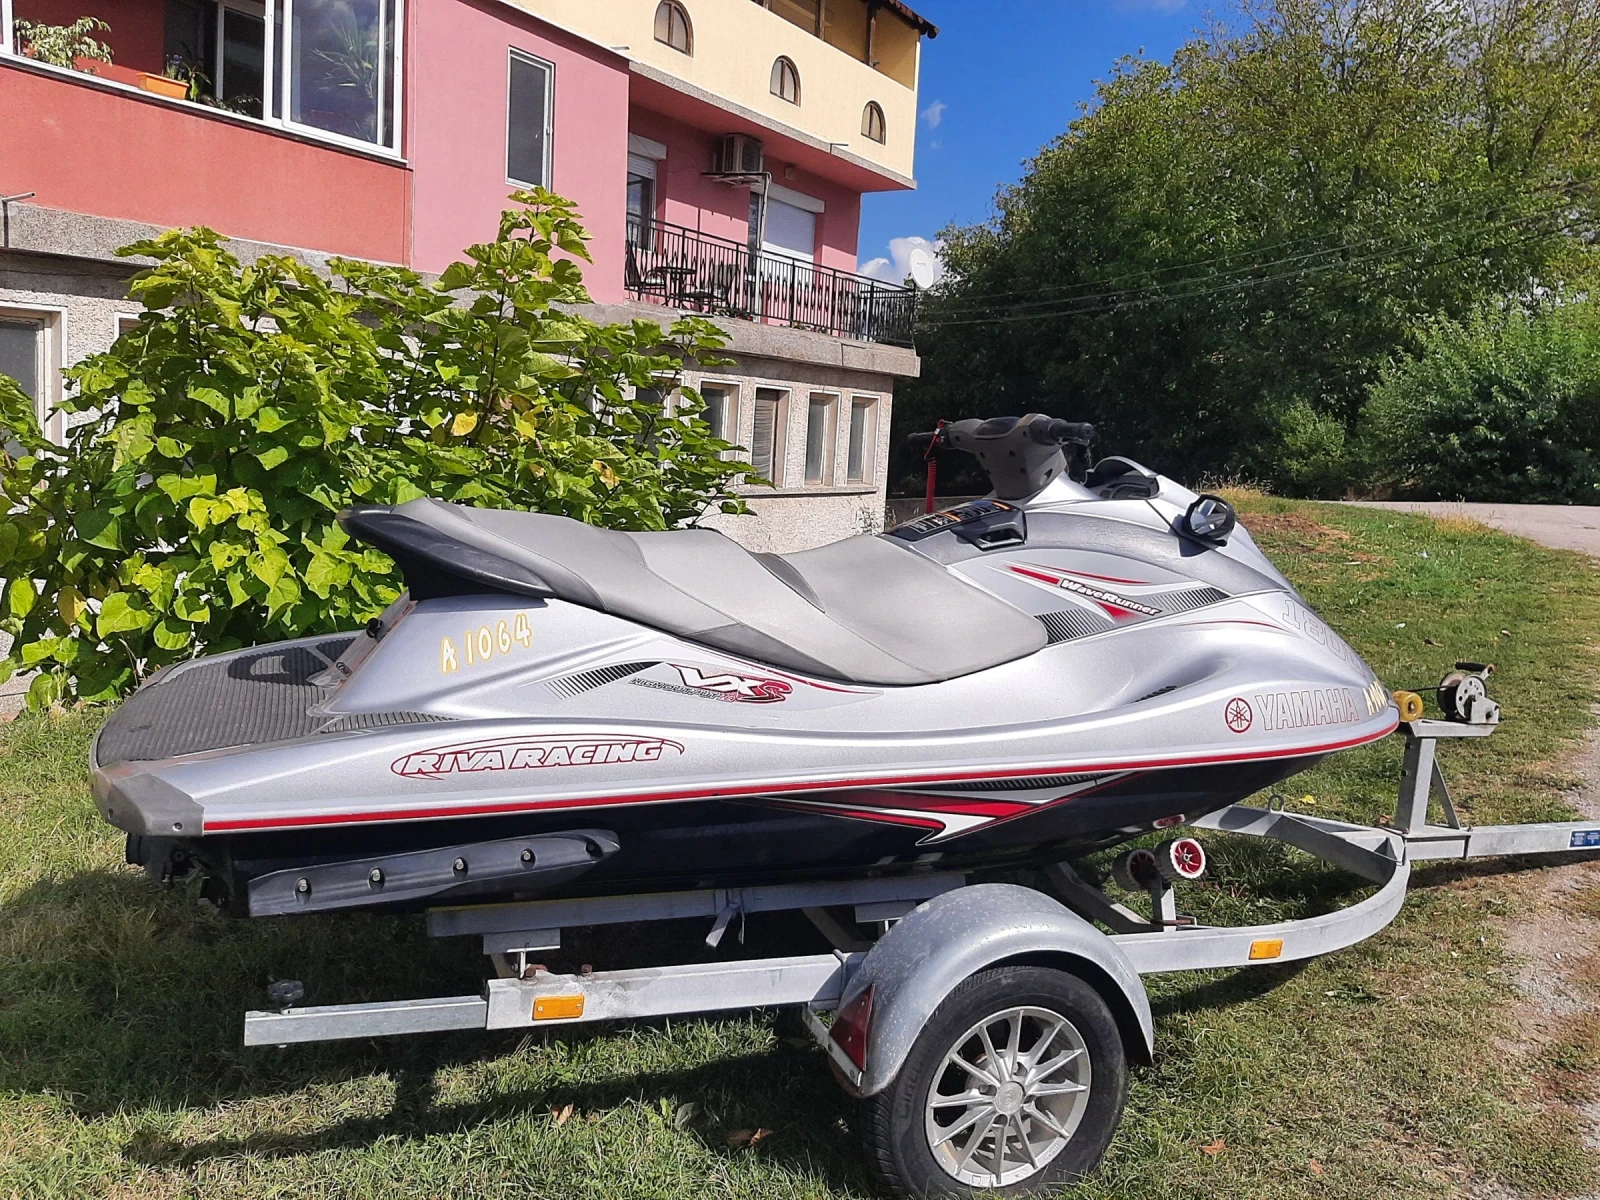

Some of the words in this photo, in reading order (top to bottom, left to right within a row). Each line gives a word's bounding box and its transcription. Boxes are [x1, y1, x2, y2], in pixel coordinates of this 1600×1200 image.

[1060, 578, 1162, 616] WaveRunner
[441, 636, 458, 674] A
[465, 613, 532, 666] 1064
[1255, 688, 1359, 731] YAMAHA
[400, 750, 505, 775] RIVA
[508, 739, 666, 770] RACING
